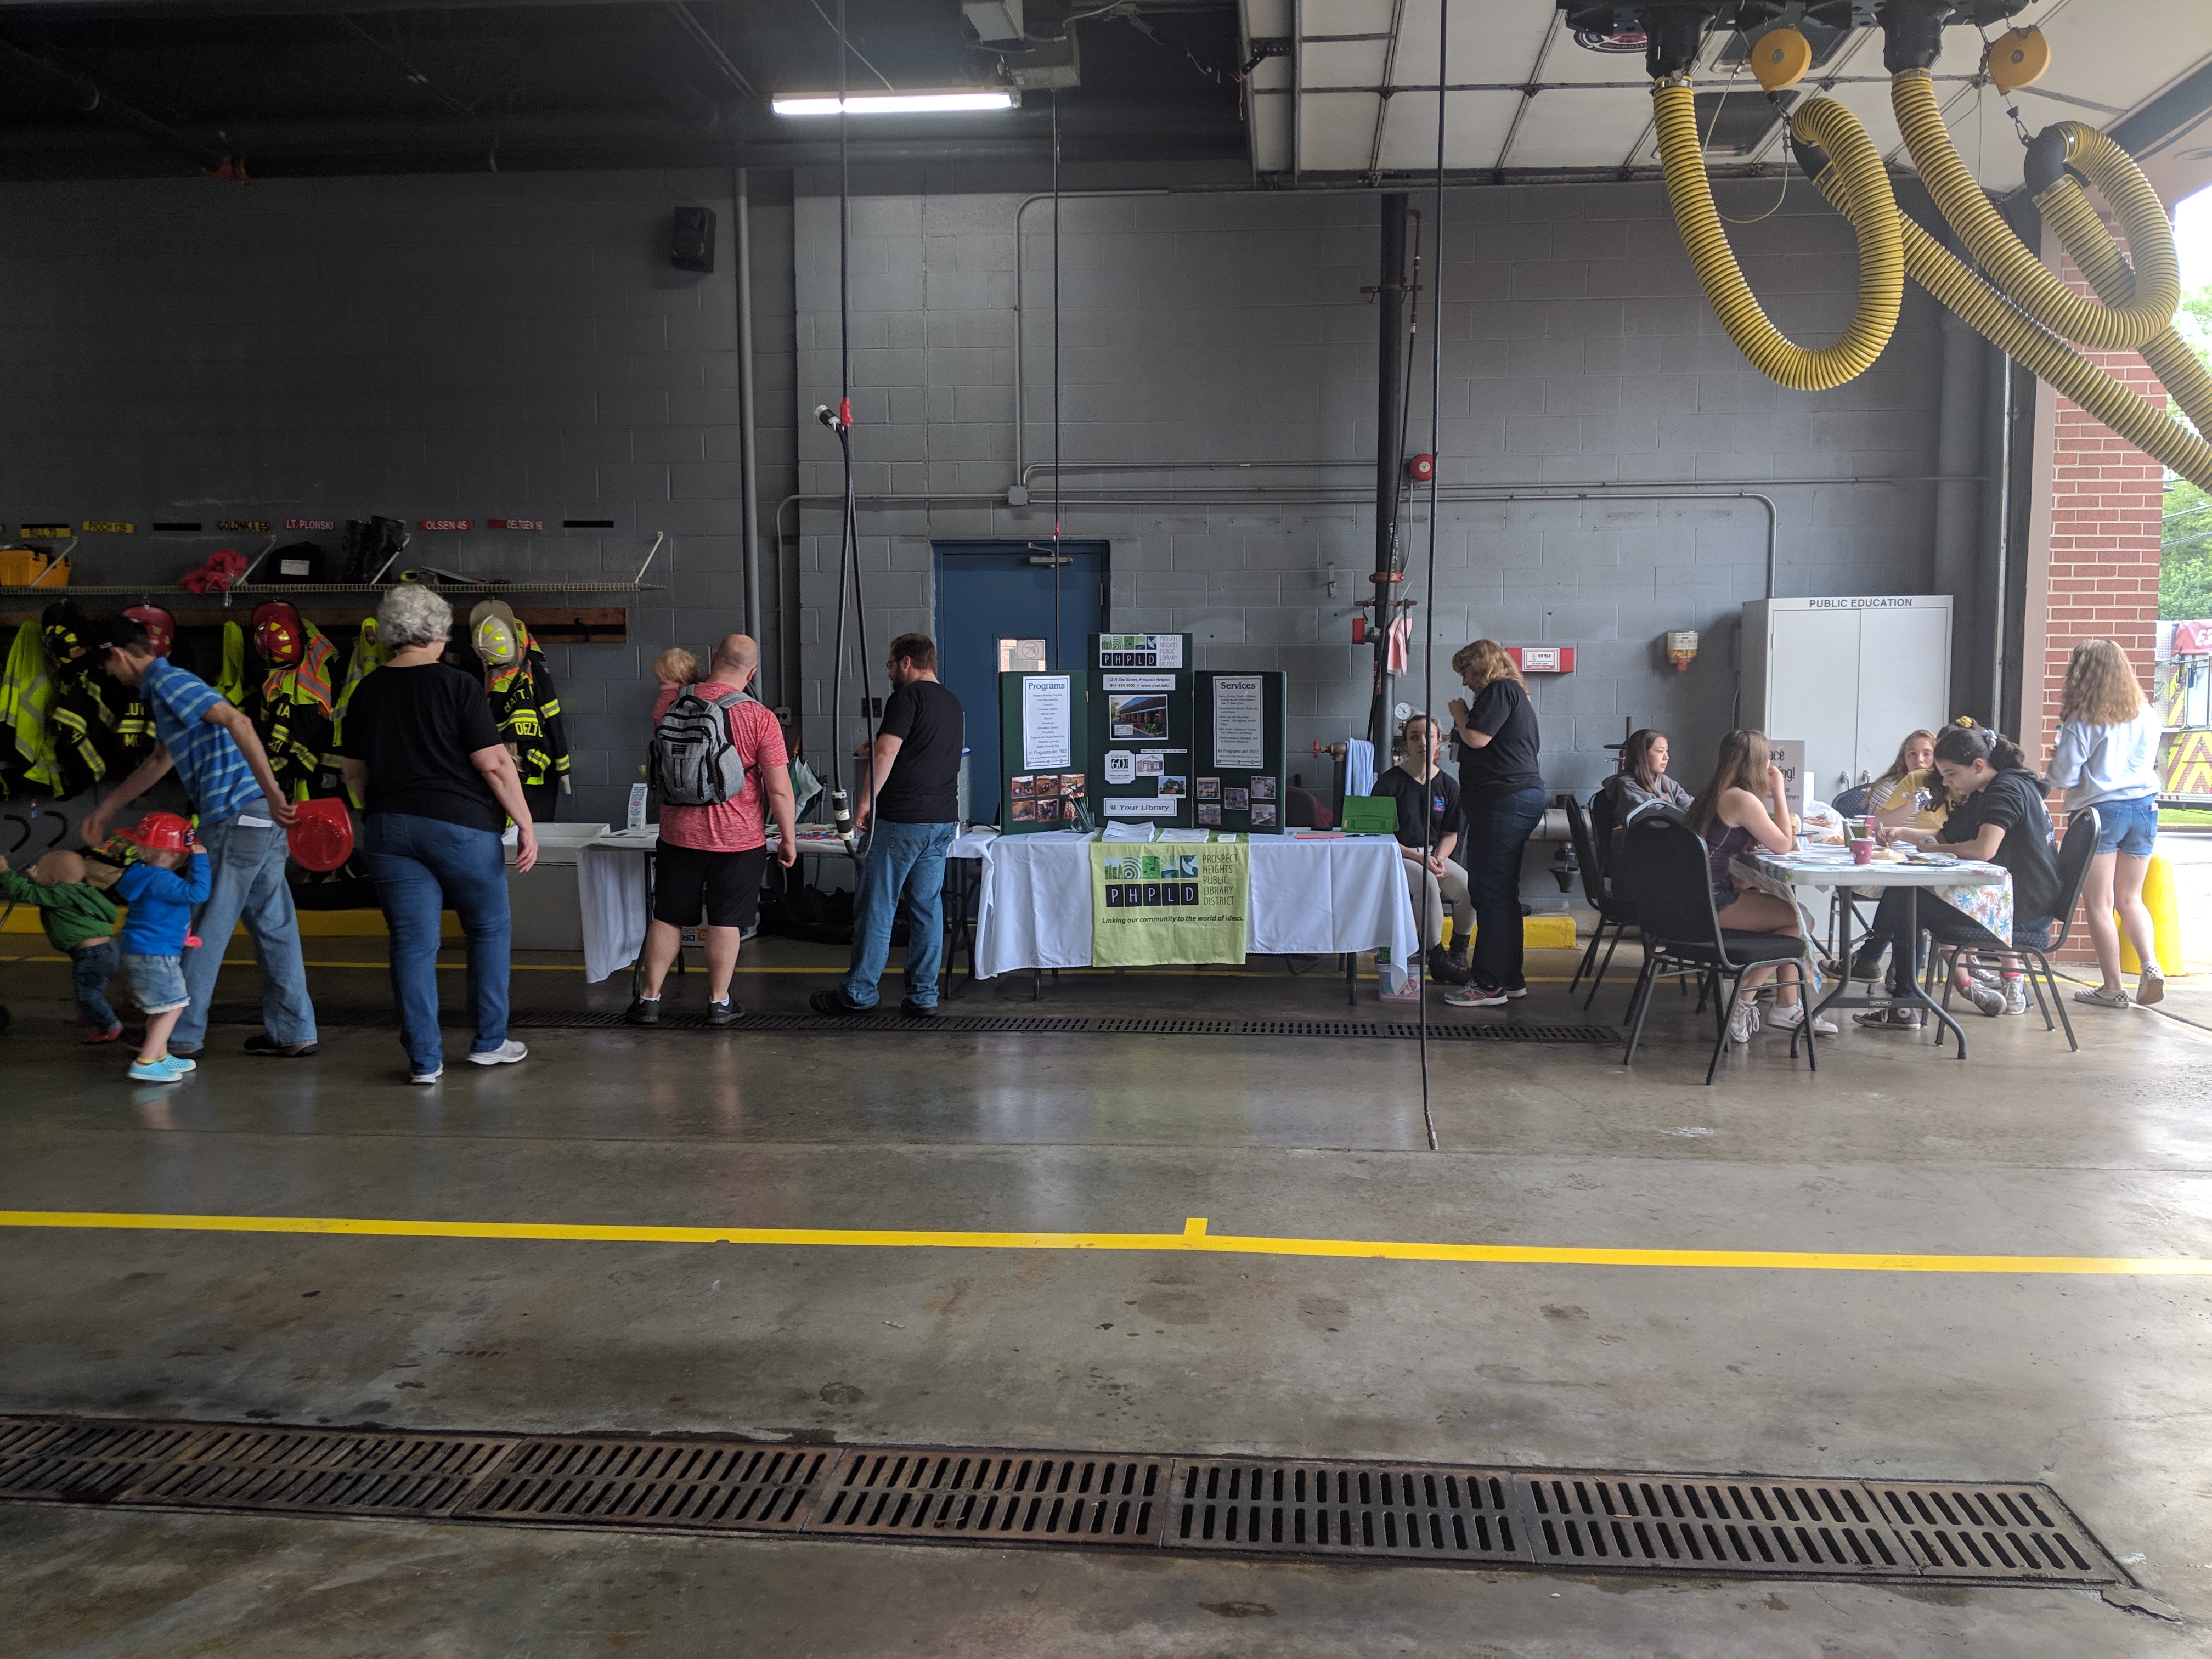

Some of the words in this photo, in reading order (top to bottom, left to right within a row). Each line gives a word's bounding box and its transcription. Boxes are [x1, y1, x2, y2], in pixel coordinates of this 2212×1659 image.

[286, 520, 298, 529] LT.
[300, 521, 334, 530] PLONSKI
[426, 521, 455, 530] OLSEN
[456, 521, 467, 530] 45
[1809, 599, 1848, 607] PUBLIC
[1851, 599, 1912, 607] EDUCATION
[1028, 682, 1065, 691] Programs
[1111, 759, 1125, 769] 60
[1203, 854, 1238, 864] PROSPECT
[1203, 865, 1233, 874] HEIGHTS
[1203, 876, 1228, 884] PUBLIC
[1203, 885, 1233, 895] LIBRARY
[1203, 896, 1234, 905] DISTRICT
[1102, 917, 1126, 925] Linking
[1139, 916, 1177, 924] community
